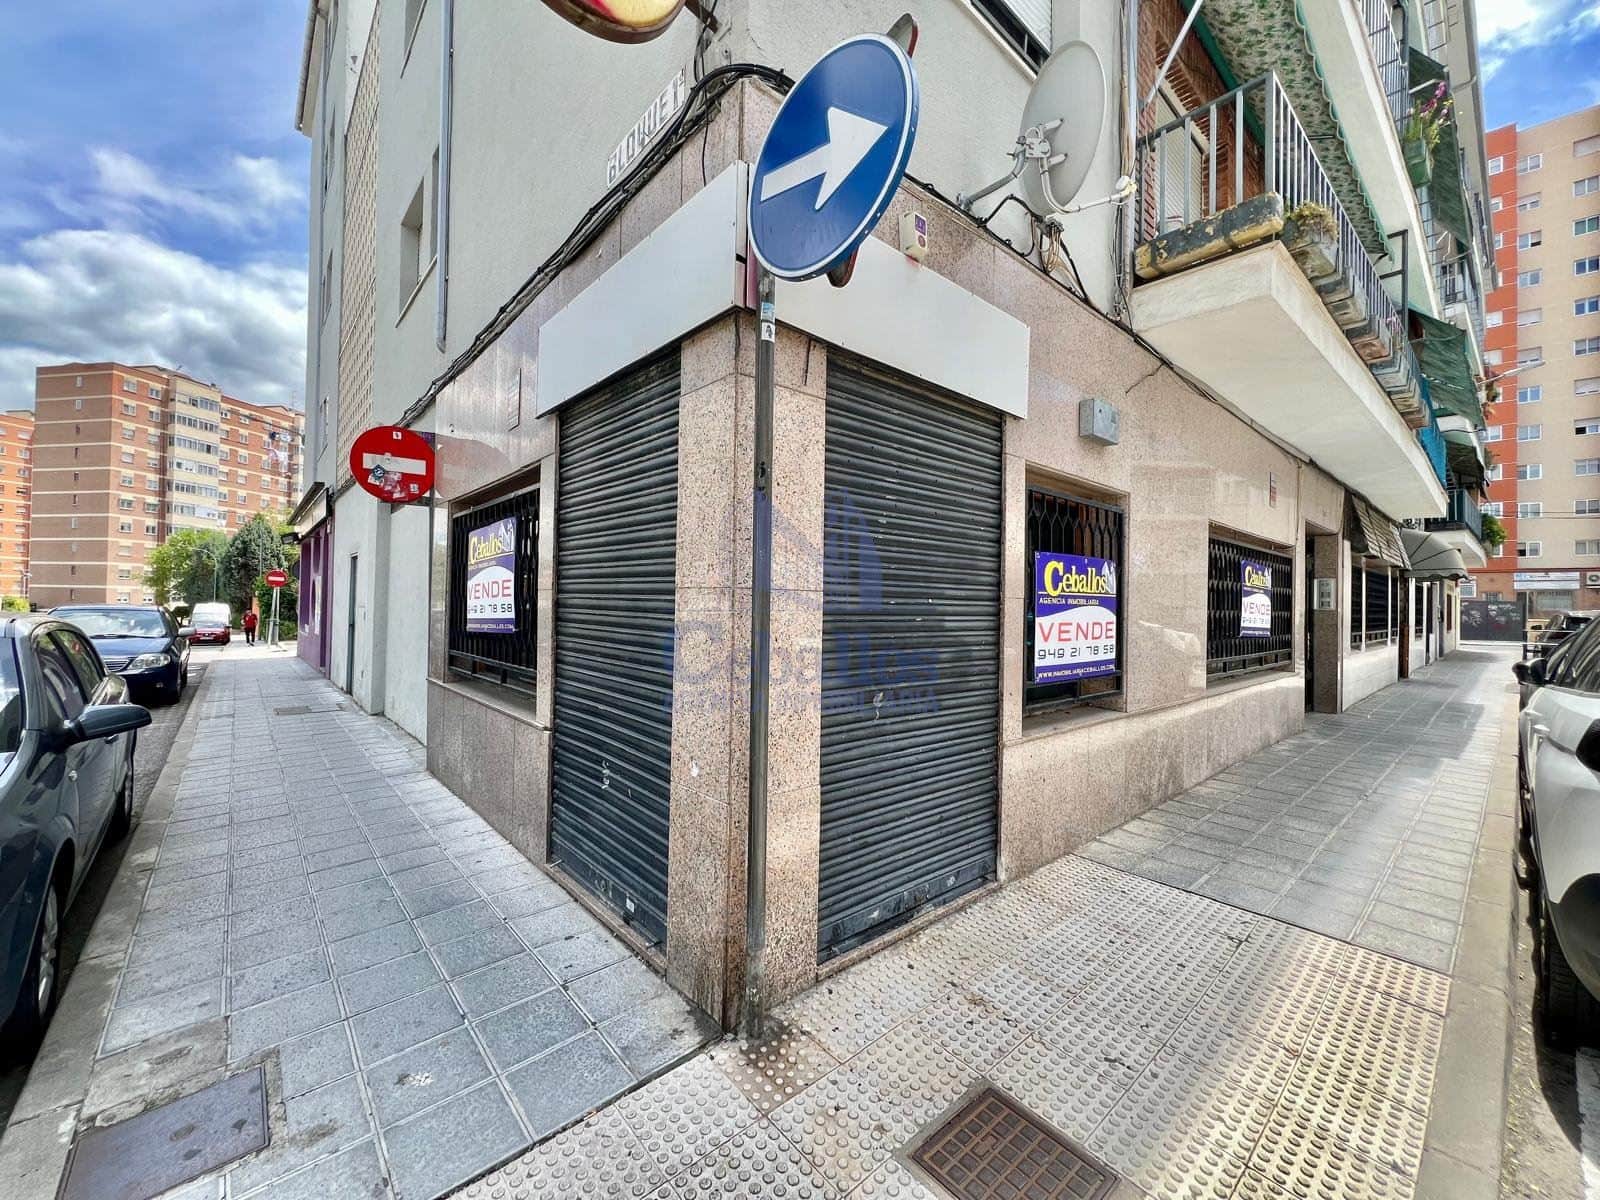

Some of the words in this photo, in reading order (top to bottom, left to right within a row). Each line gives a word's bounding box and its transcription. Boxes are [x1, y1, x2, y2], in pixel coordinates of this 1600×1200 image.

[607, 87, 669, 185] BLOQUE
[1044, 560, 1107, 597] Ceballos
[467, 578, 513, 601] VENDE
[500, 602, 513, 613] 58
[1038, 597, 1066, 605] AGENCIA
[1243, 602, 1271, 617] VENDE
[1038, 620, 1115, 643] VENDE
[1038, 647, 1065, 660] 949
[1070, 646, 1081, 658] 21
[1085, 645, 1100, 656] 78
[1103, 643, 1115, 655] 58
